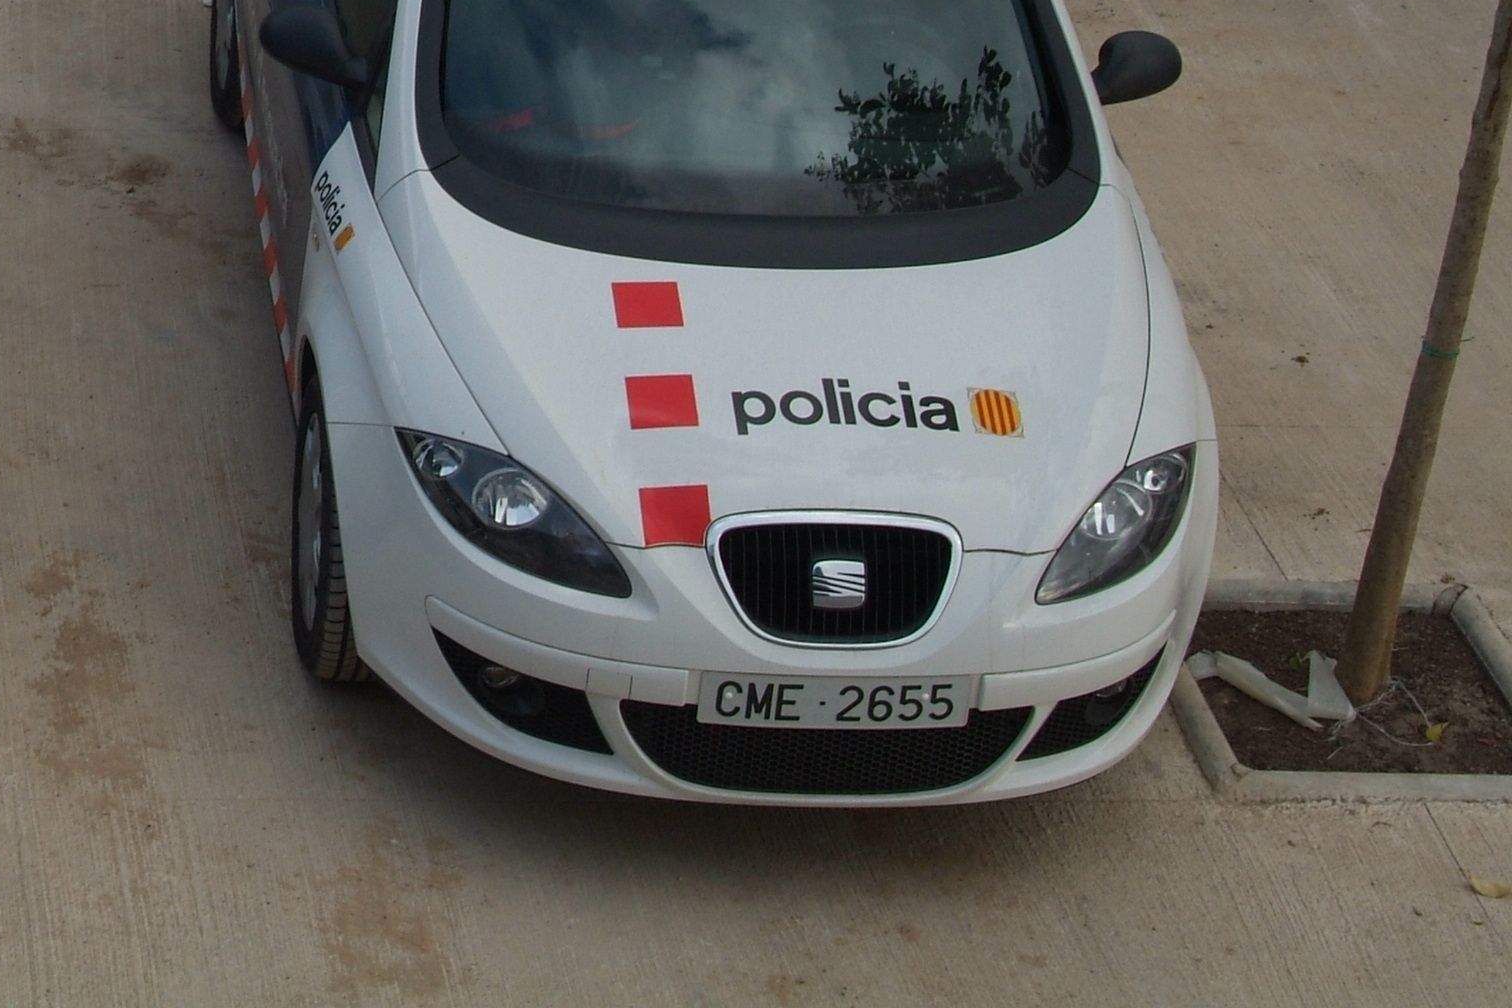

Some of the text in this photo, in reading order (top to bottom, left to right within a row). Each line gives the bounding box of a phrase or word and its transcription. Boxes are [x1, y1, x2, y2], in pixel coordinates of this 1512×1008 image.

[315, 171, 345, 236] policia
[731, 378, 960, 435] policia
[715, 680, 954, 723] CME 2655
